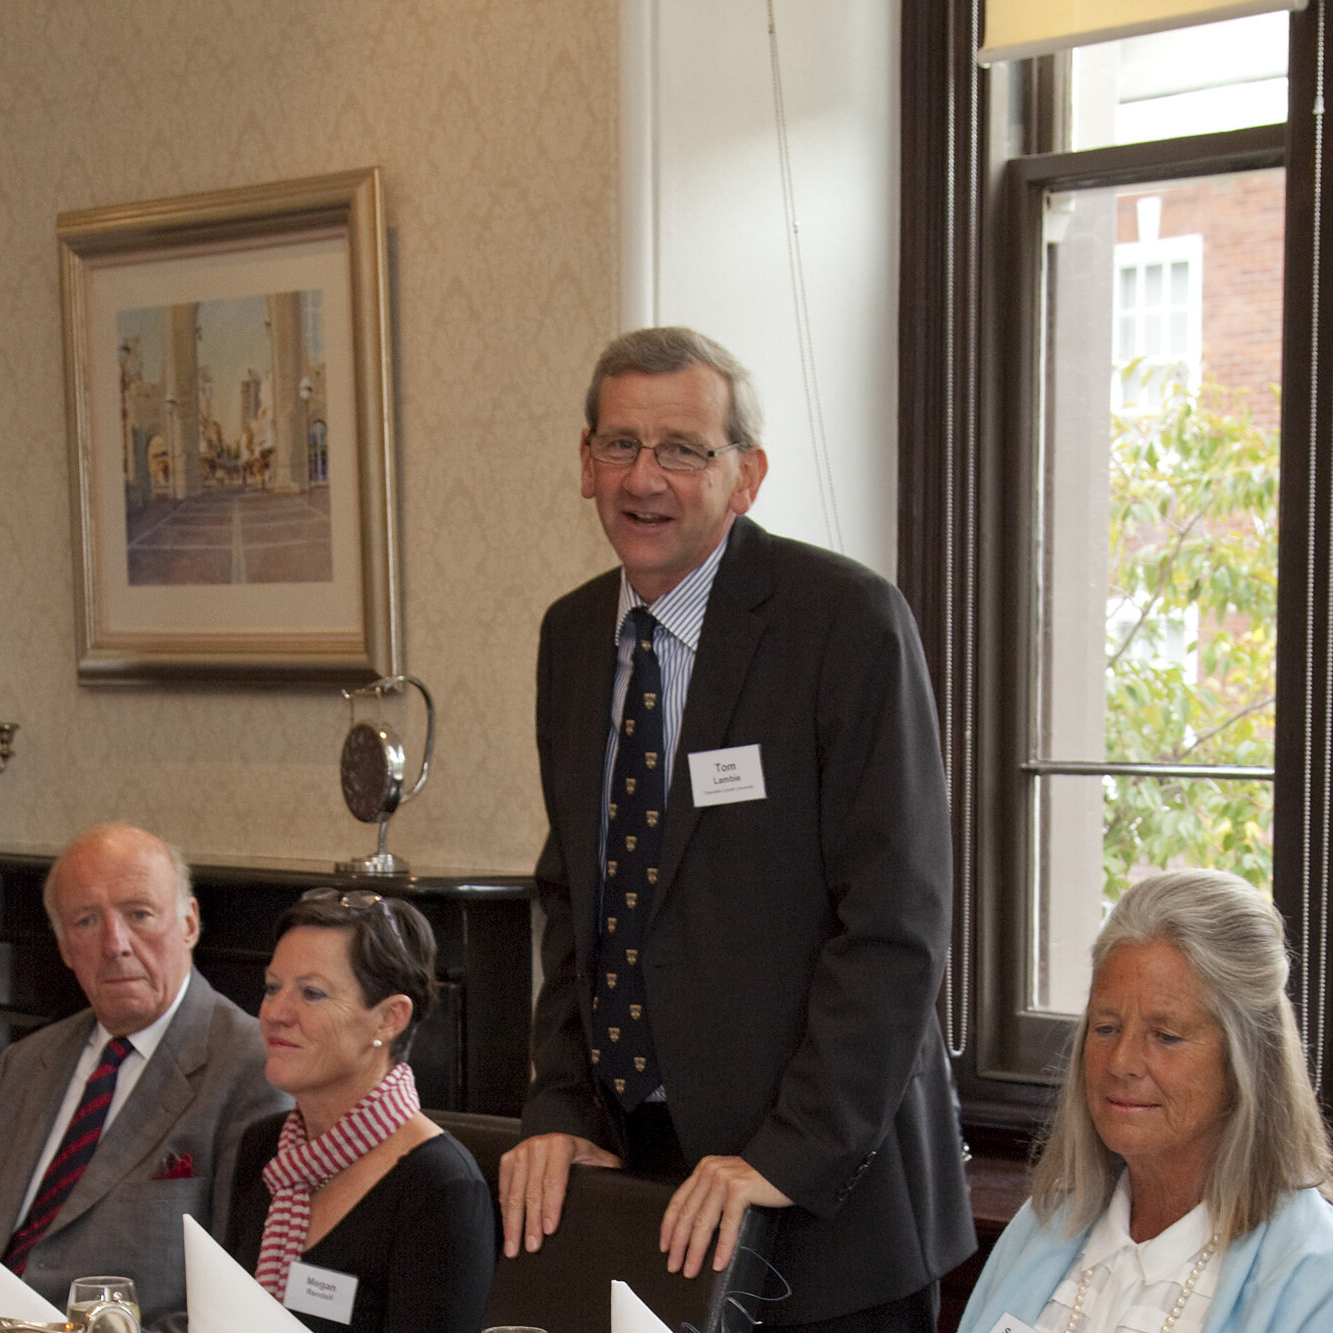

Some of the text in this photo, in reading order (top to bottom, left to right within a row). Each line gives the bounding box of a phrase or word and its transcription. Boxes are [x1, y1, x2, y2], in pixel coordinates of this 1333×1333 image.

[714, 762, 737, 773] Tom
[713, 774, 742, 785] Lambie
[307, 1276, 337, 1292] Megan
